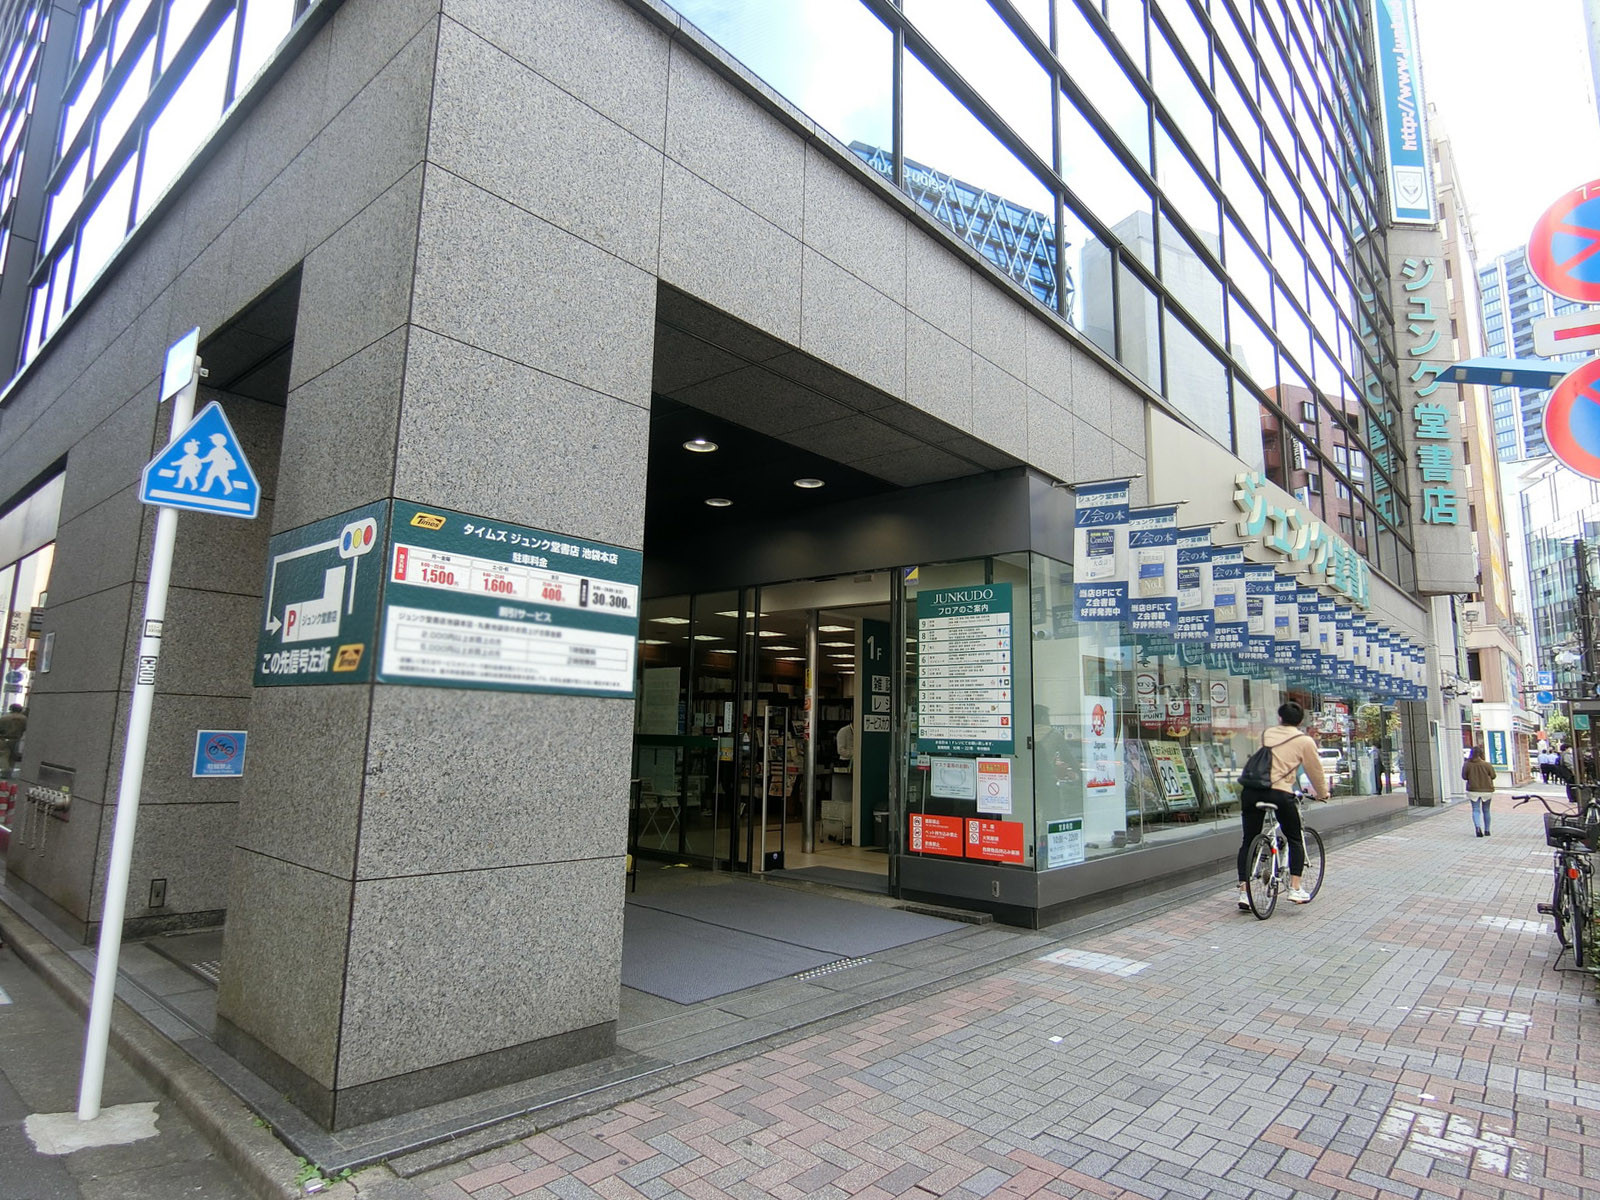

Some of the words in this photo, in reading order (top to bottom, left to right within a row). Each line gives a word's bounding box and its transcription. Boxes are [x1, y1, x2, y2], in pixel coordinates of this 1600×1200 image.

[1402, 258, 1458, 525] ジュンク堂書店
[1078, 508, 1125, 525] Z会の本
[417, 518, 439, 528] Times
[1129, 531, 1173, 546] Z会の本
[463, 523, 508, 542] タイムズ
[510, 533, 580, 557] ジュンク堂書店
[582, 547, 619, 565] 池袋本店
[512, 552, 548, 568] 駐車料金
[1178, 550, 1209, 563] 会の本
[1214, 566, 1242, 578] 会の本
[1246, 582, 1272, 593] 会の本
[933, 588, 994, 604] JUNKUDO
[1079, 588, 1123, 598] 当店8Fにて
[1085, 598, 1116, 607] Z会書籍
[1131, 603, 1172, 612] 当店8Fにて
[938, 604, 989, 615] フロアのご案内
[1080, 607, 1121, 617] 好評発売中
[1137, 612, 1166, 620] Z会書籍
[1178, 615, 1210, 623] 店8Fにて
[287, 610, 297, 636] P
[921, 620, 927, 629] 9
[1132, 621, 1171, 629] 好評発売中
[921, 632, 927, 640] 8
[1214, 627, 1244, 635] 店8Fにて
[867, 635, 882, 660] 1F
[262, 646, 331, 674] この先信号左折
[921, 656, 927, 664] 6
[921, 668, 927, 676] 5
[921, 680, 927, 688] 4
[921, 692, 927, 700] 3
[921, 704, 927, 712] 2
[1196, 703, 1205, 714] R
[920, 729, 928, 737] B1
[1160, 766, 1179, 794] 86
